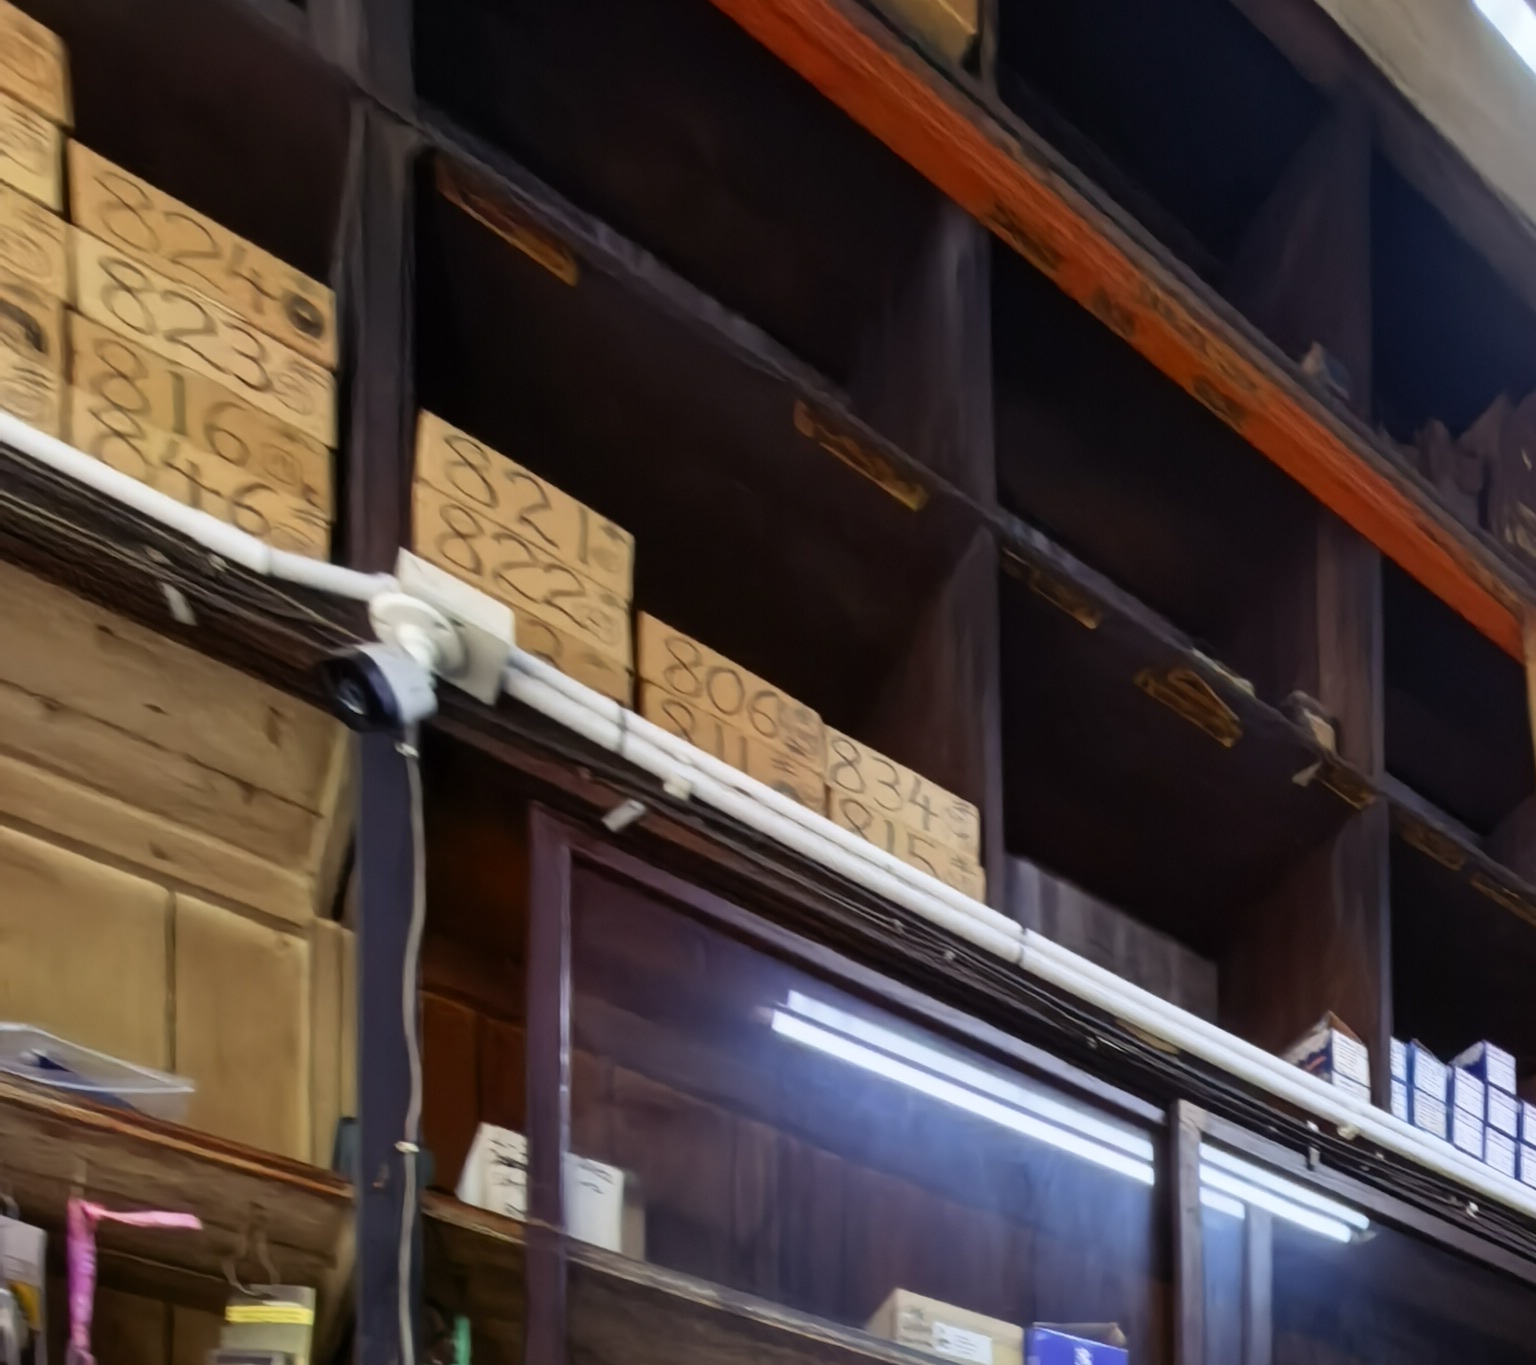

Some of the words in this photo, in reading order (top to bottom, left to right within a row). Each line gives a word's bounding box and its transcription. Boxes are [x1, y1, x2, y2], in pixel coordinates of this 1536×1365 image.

[98, 255, 273, 392] 823
[89, 337, 250, 468] 816
[443, 434, 590, 566] 821
[435, 503, 587, 630] 822
[663, 636, 779, 739] 806
[829, 737, 938, 832] 834
